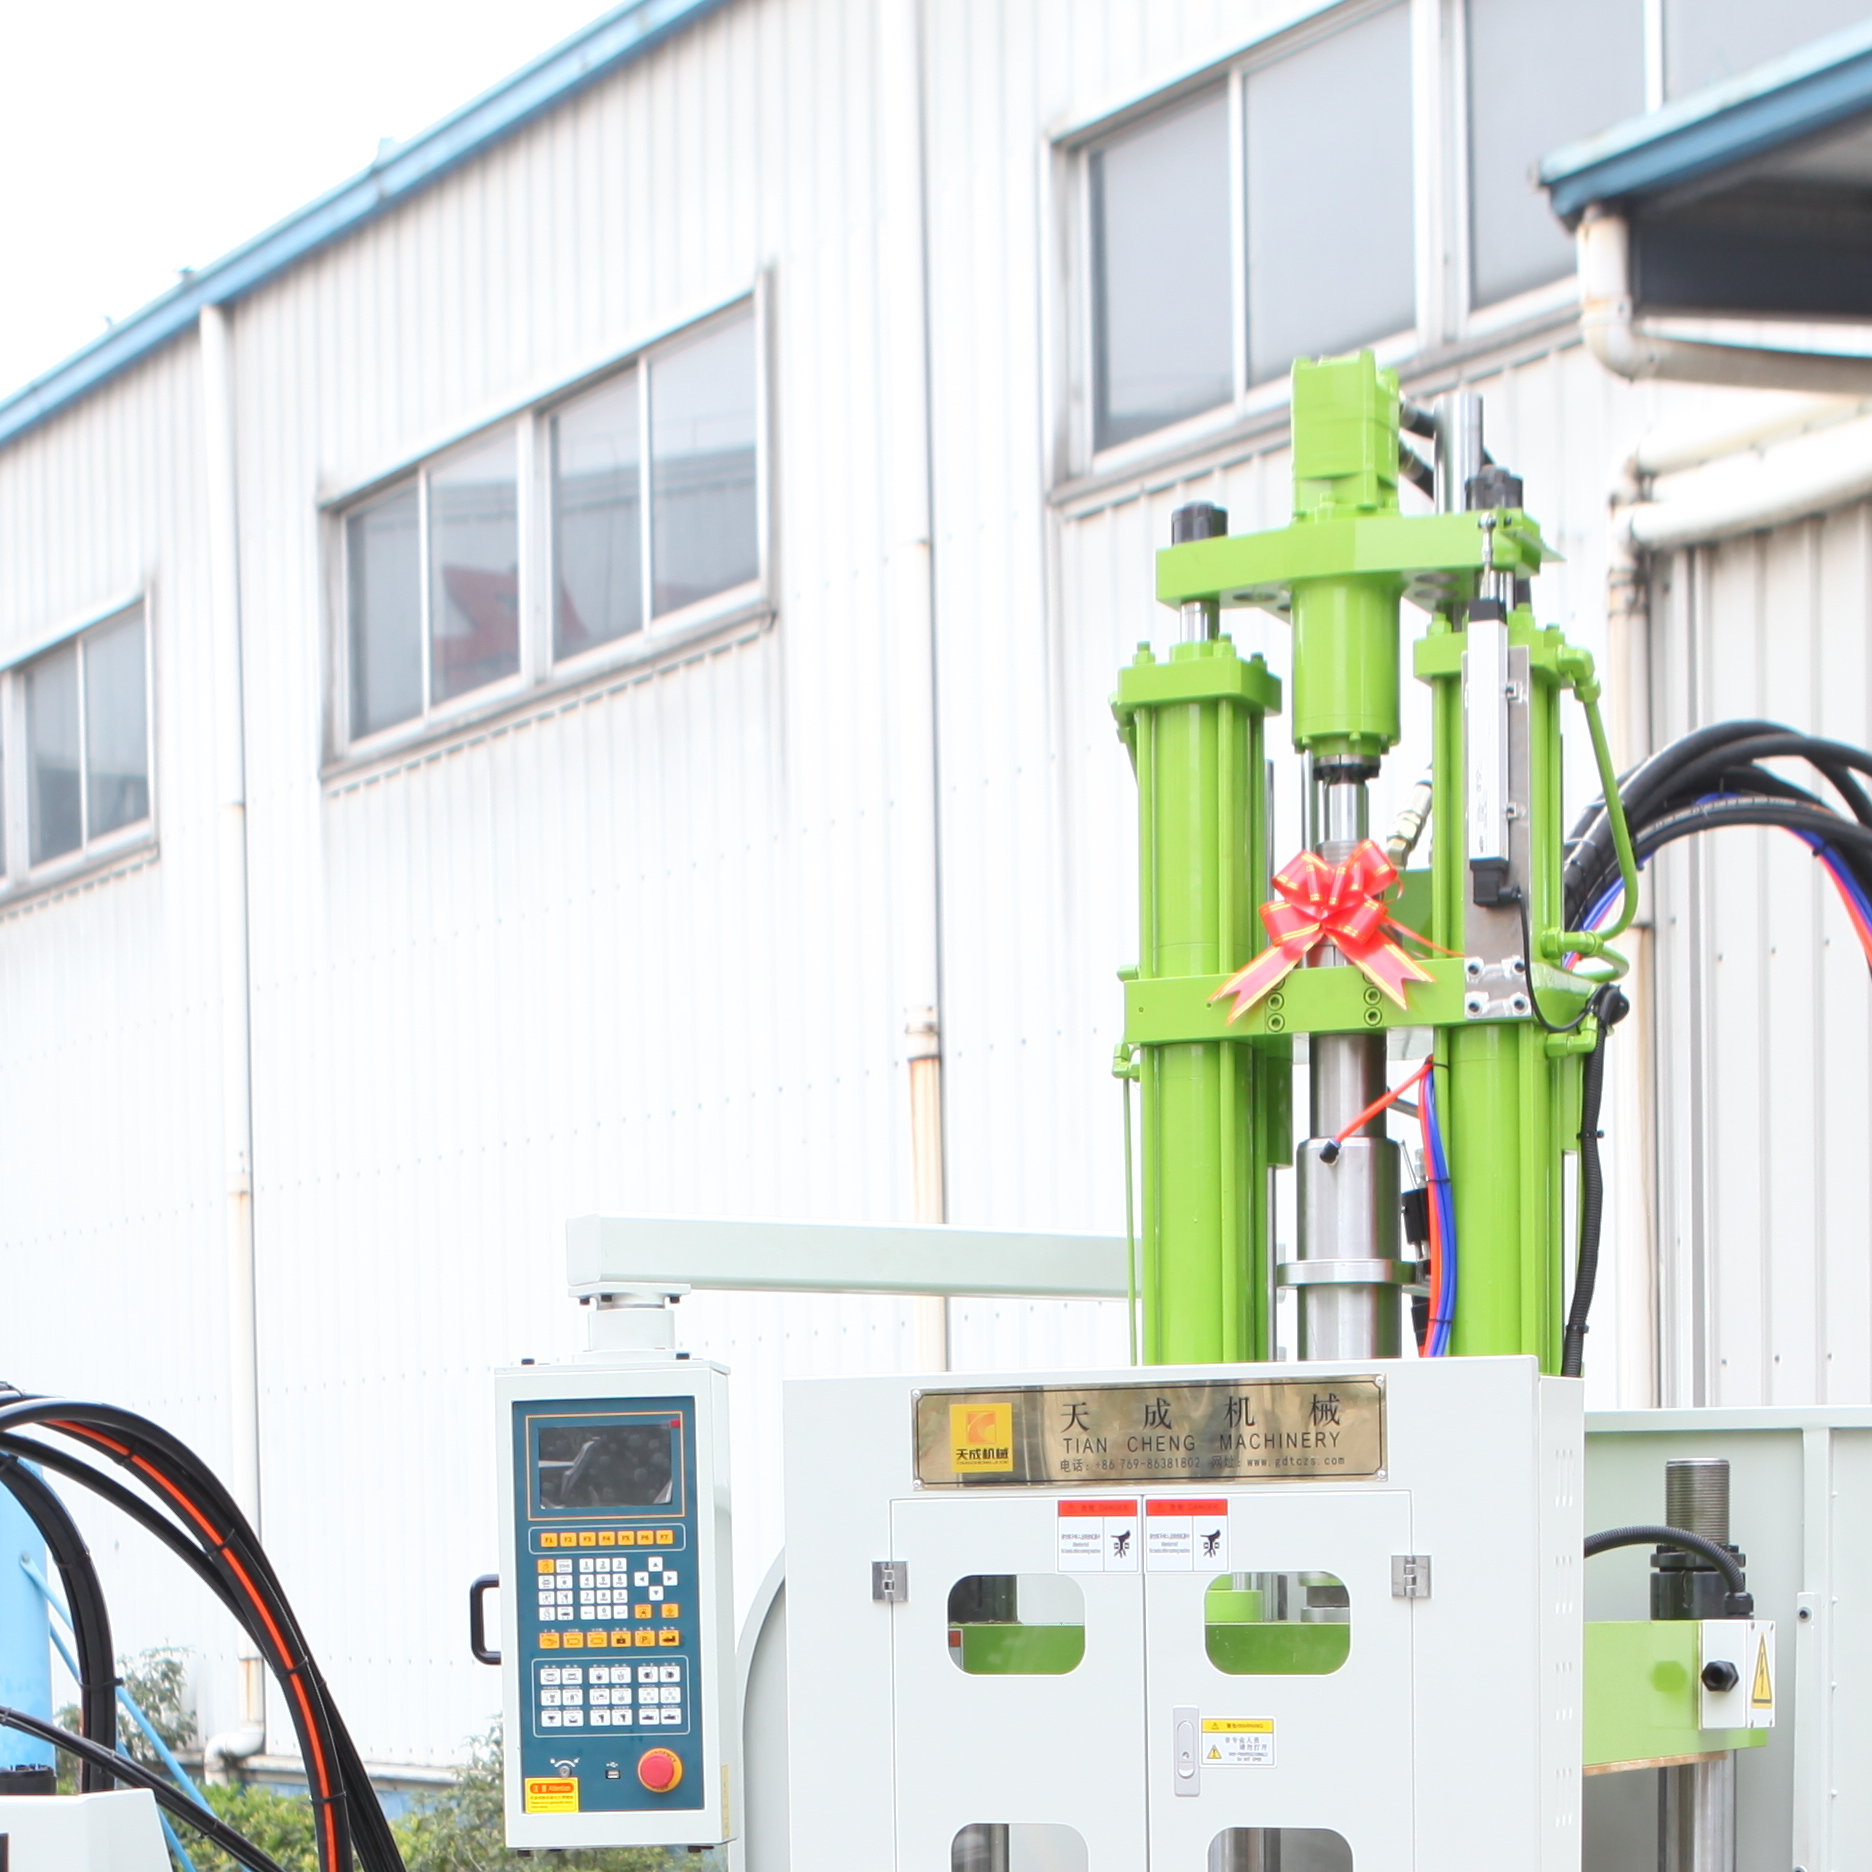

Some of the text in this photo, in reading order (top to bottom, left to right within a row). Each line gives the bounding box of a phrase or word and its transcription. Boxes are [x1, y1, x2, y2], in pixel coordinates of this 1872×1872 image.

[1060, 1393, 1342, 1432] 天成机械
[1063, 1431, 1341, 1455] TIAN CHENG MACHINERY
[955, 1446, 1009, 1460] 天成机械
[1119, 1457, 1201, 1471] 769-86381802
